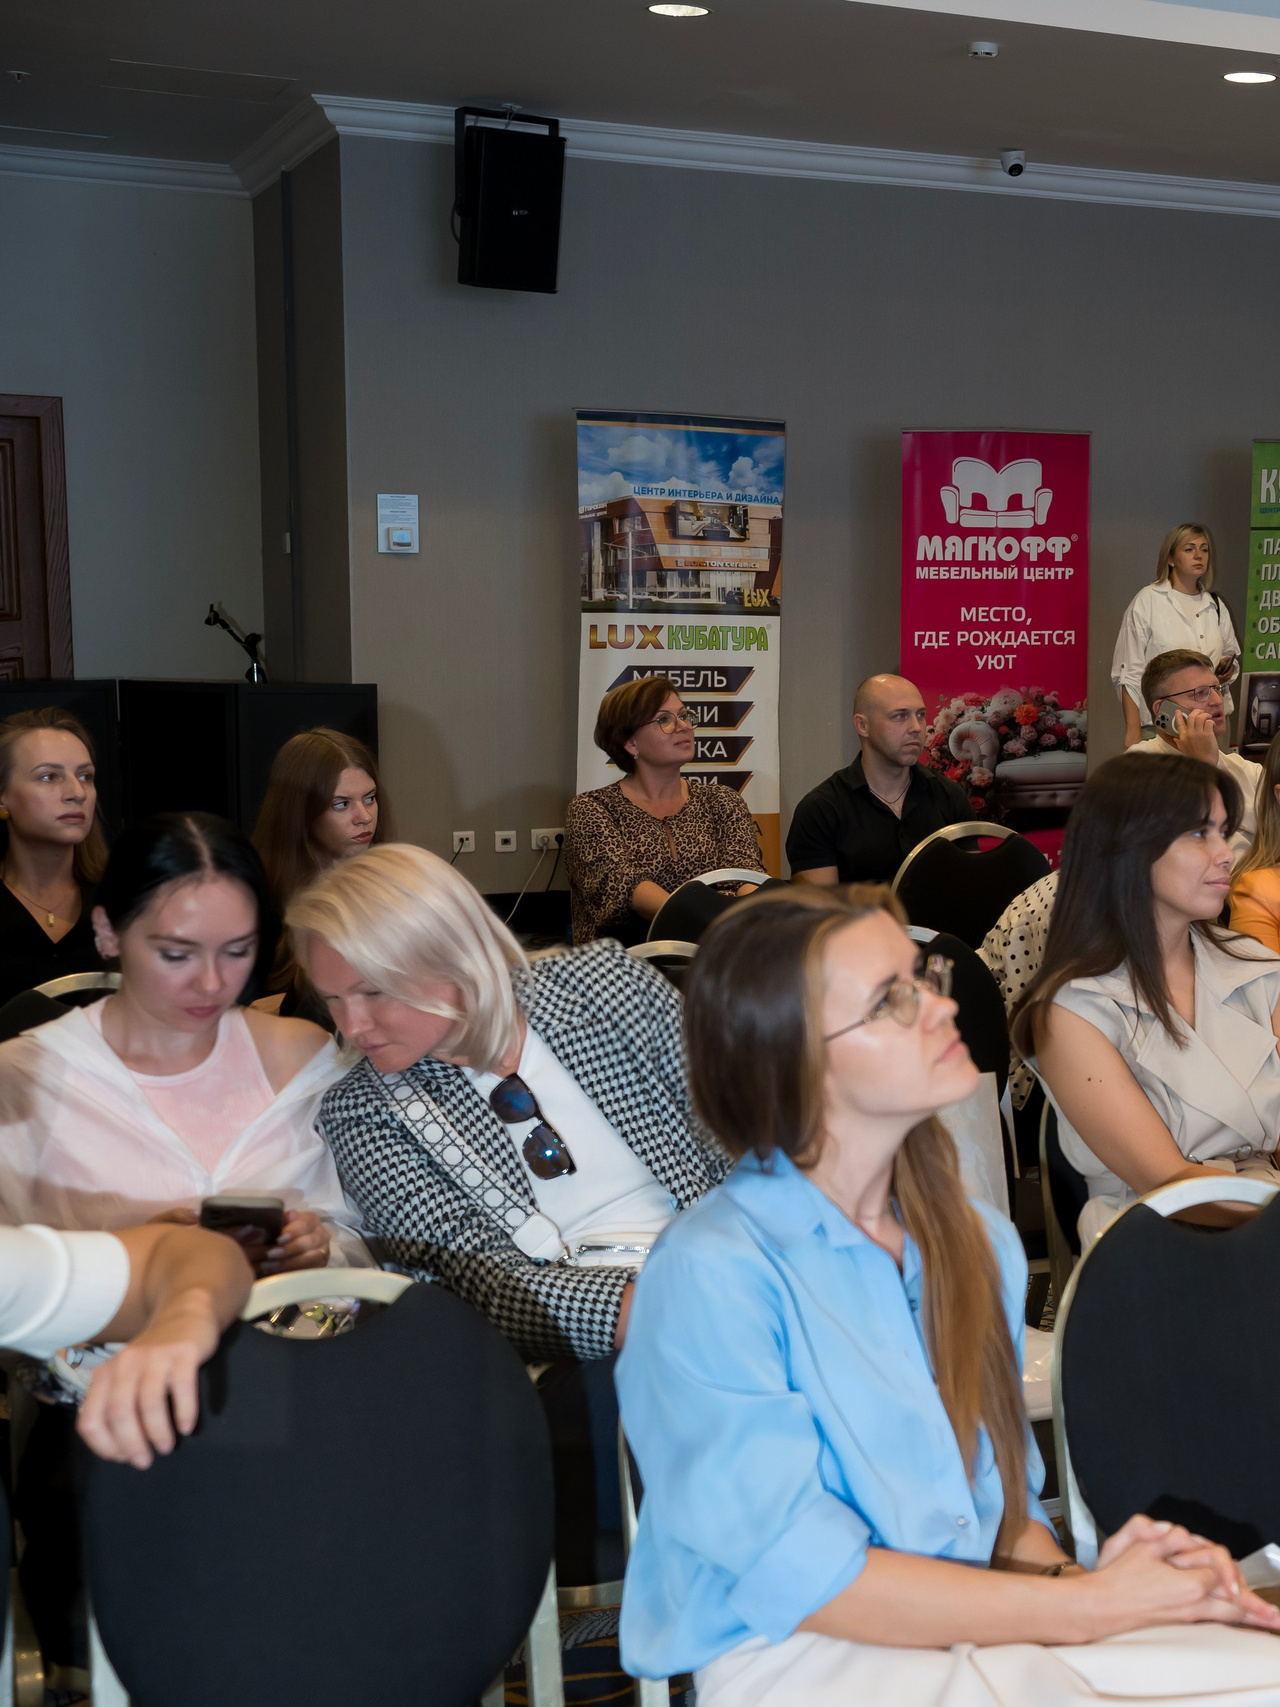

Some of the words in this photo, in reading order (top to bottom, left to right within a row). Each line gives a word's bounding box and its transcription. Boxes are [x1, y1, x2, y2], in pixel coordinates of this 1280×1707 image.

[633, 486, 665, 497] ЦЕНТР
[668, 488, 724, 500] ИНТЕРЬЕРА
[727, 492, 733, 501] И
[735, 492, 779, 504] ДИЗАЙНА
[916, 535, 1072, 562] МЯГКОФФ
[916, 565, 1019, 579] МЕБЕЛЬНЫЙ
[1023, 567, 1075, 582] ЦЕНТР
[743, 588, 771, 608] LUX
[960, 606, 1033, 625] МЕСТО,
[589, 624, 665, 649] LUX
[667, 624, 769, 651] КУБАТУРА
[914, 631, 950, 649] ГДЕ
[957, 630, 1076, 648] РОЖДАЕТСЯ
[975, 655, 1017, 670] УЮТ
